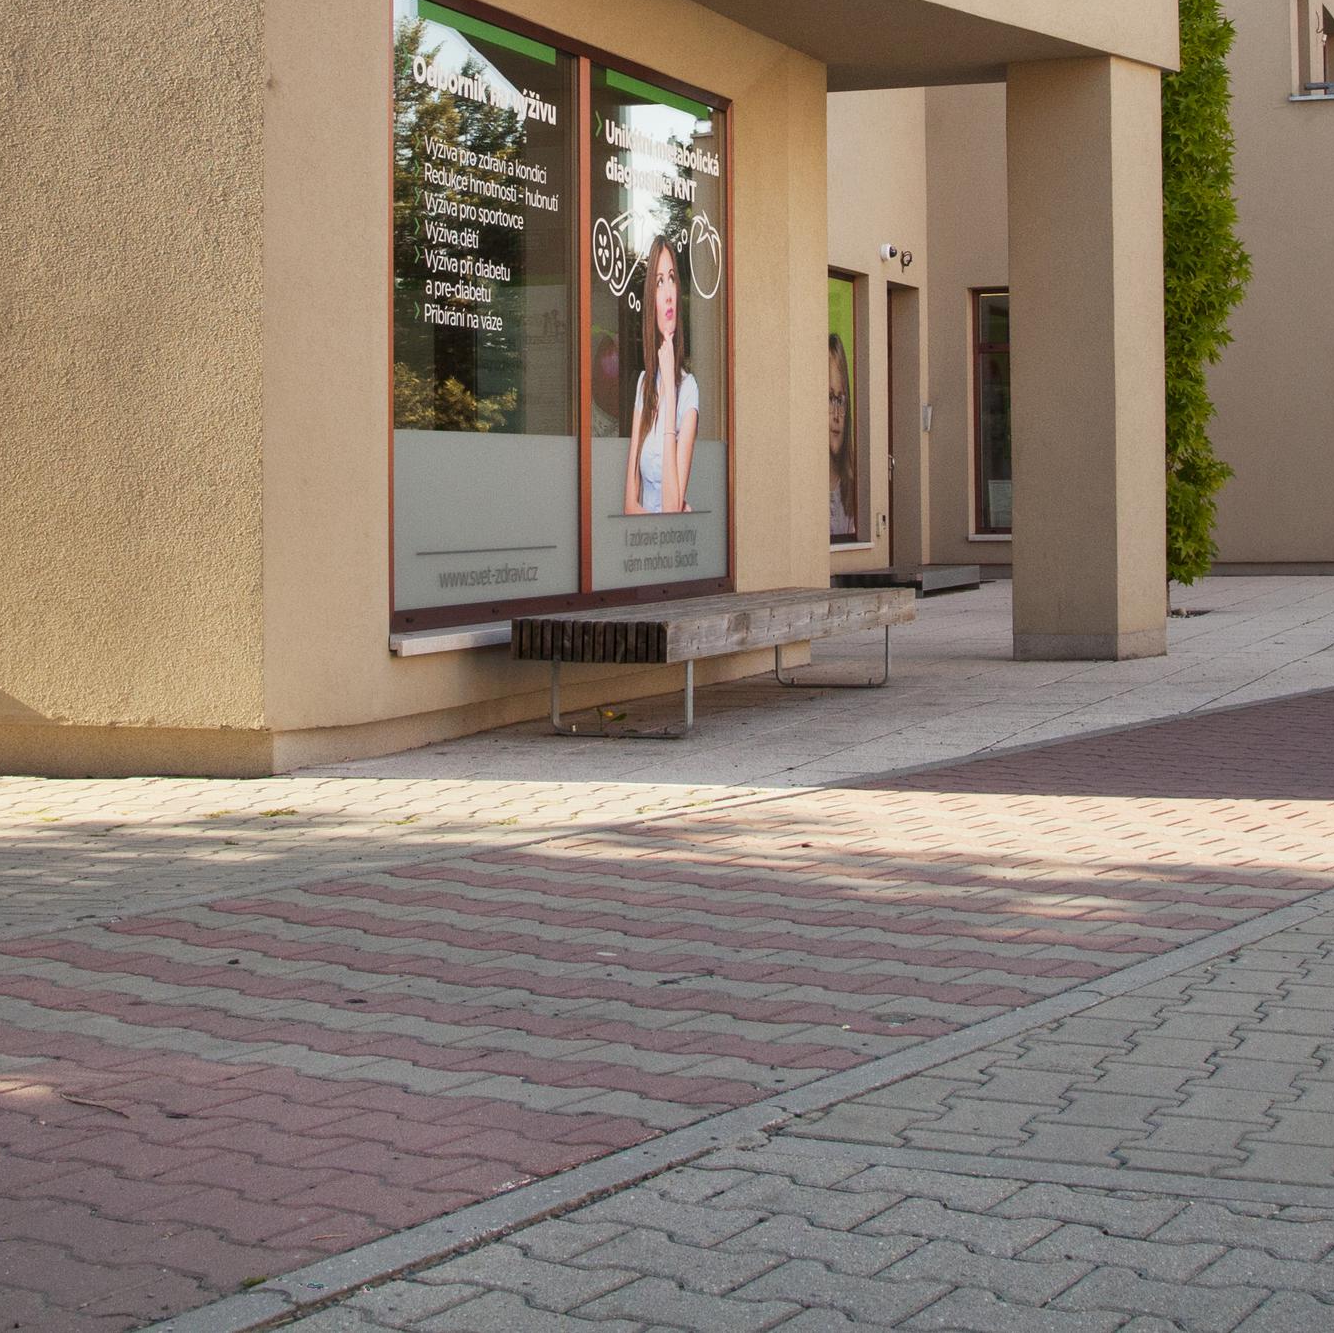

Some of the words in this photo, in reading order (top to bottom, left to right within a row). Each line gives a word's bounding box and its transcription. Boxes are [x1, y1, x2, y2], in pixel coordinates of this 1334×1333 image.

[514, 88, 557, 126] výživu
[424, 135, 458, 160] Výživa
[460, 149, 477, 167] pro
[508, 161, 514, 176] a
[516, 159, 547, 185] kondici
[424, 163, 468, 191] Redukce
[470, 174, 517, 203] hmotnosti
[525, 187, 559, 212] hubnutí
[674, 177, 698, 203] KNT
[424, 191, 458, 215] Výživa
[460, 203, 477, 222] pro
[478, 207, 524, 230] sportovce
[424, 220, 458, 245] Výživa
[460, 228, 480, 249] dětí
[424, 248, 458, 273] Výživa
[460, 255, 473, 277] při
[475, 258, 511, 282] diabetu
[425, 279, 433, 295] a
[434, 279, 492, 303] pre-diabetu
[424, 303, 466, 328] Přibírání
[467, 312, 479, 329] na
[481, 311, 503, 332] váze
[660, 528, 697, 548] potraviny
